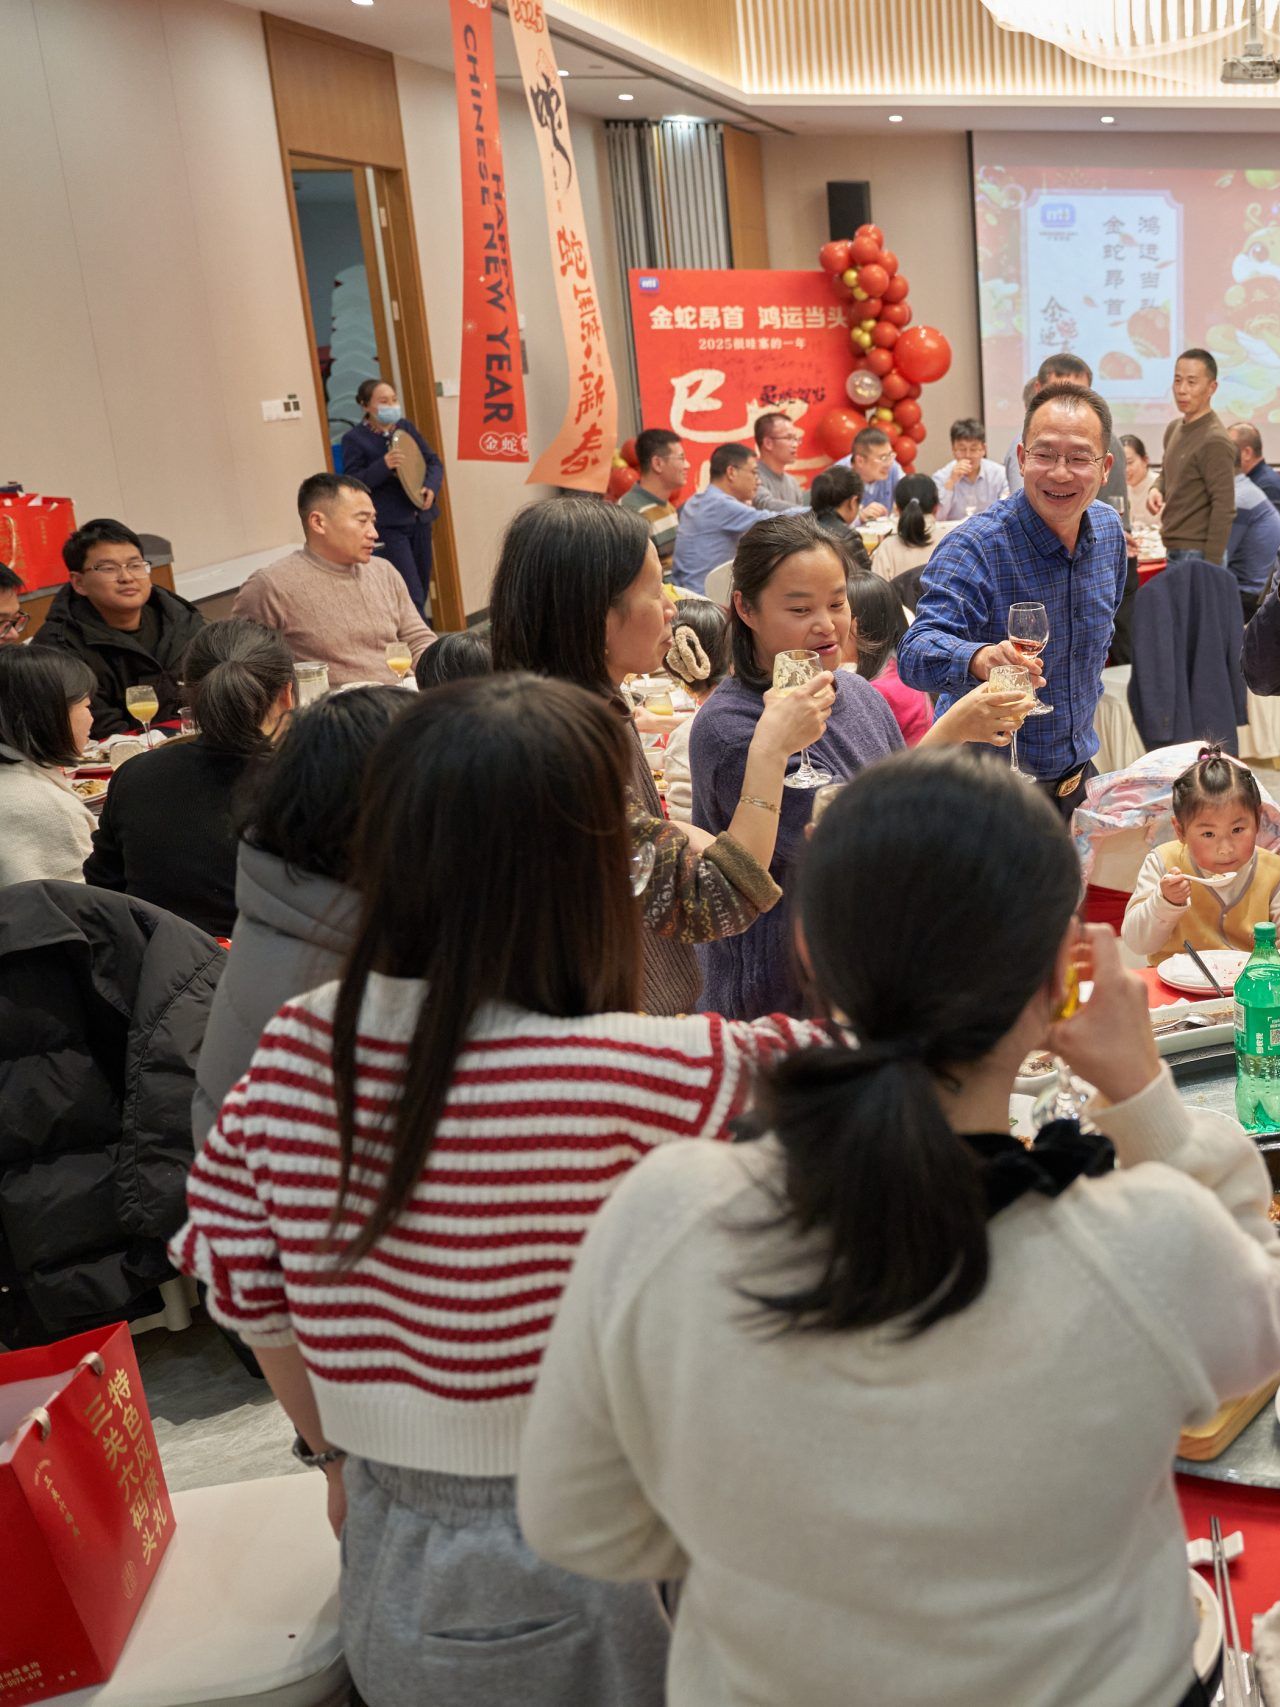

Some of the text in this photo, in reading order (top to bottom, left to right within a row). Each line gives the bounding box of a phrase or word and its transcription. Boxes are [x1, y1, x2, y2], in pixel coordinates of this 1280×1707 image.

[464, 24, 491, 205] CHINESE
[483, 223, 505, 312] NEW
[649, 305, 849, 330] 金蛇昂首 鸿运当头
[483, 326, 514, 424] YEAR
[108, 1368, 168, 1537] 特色风味礼
